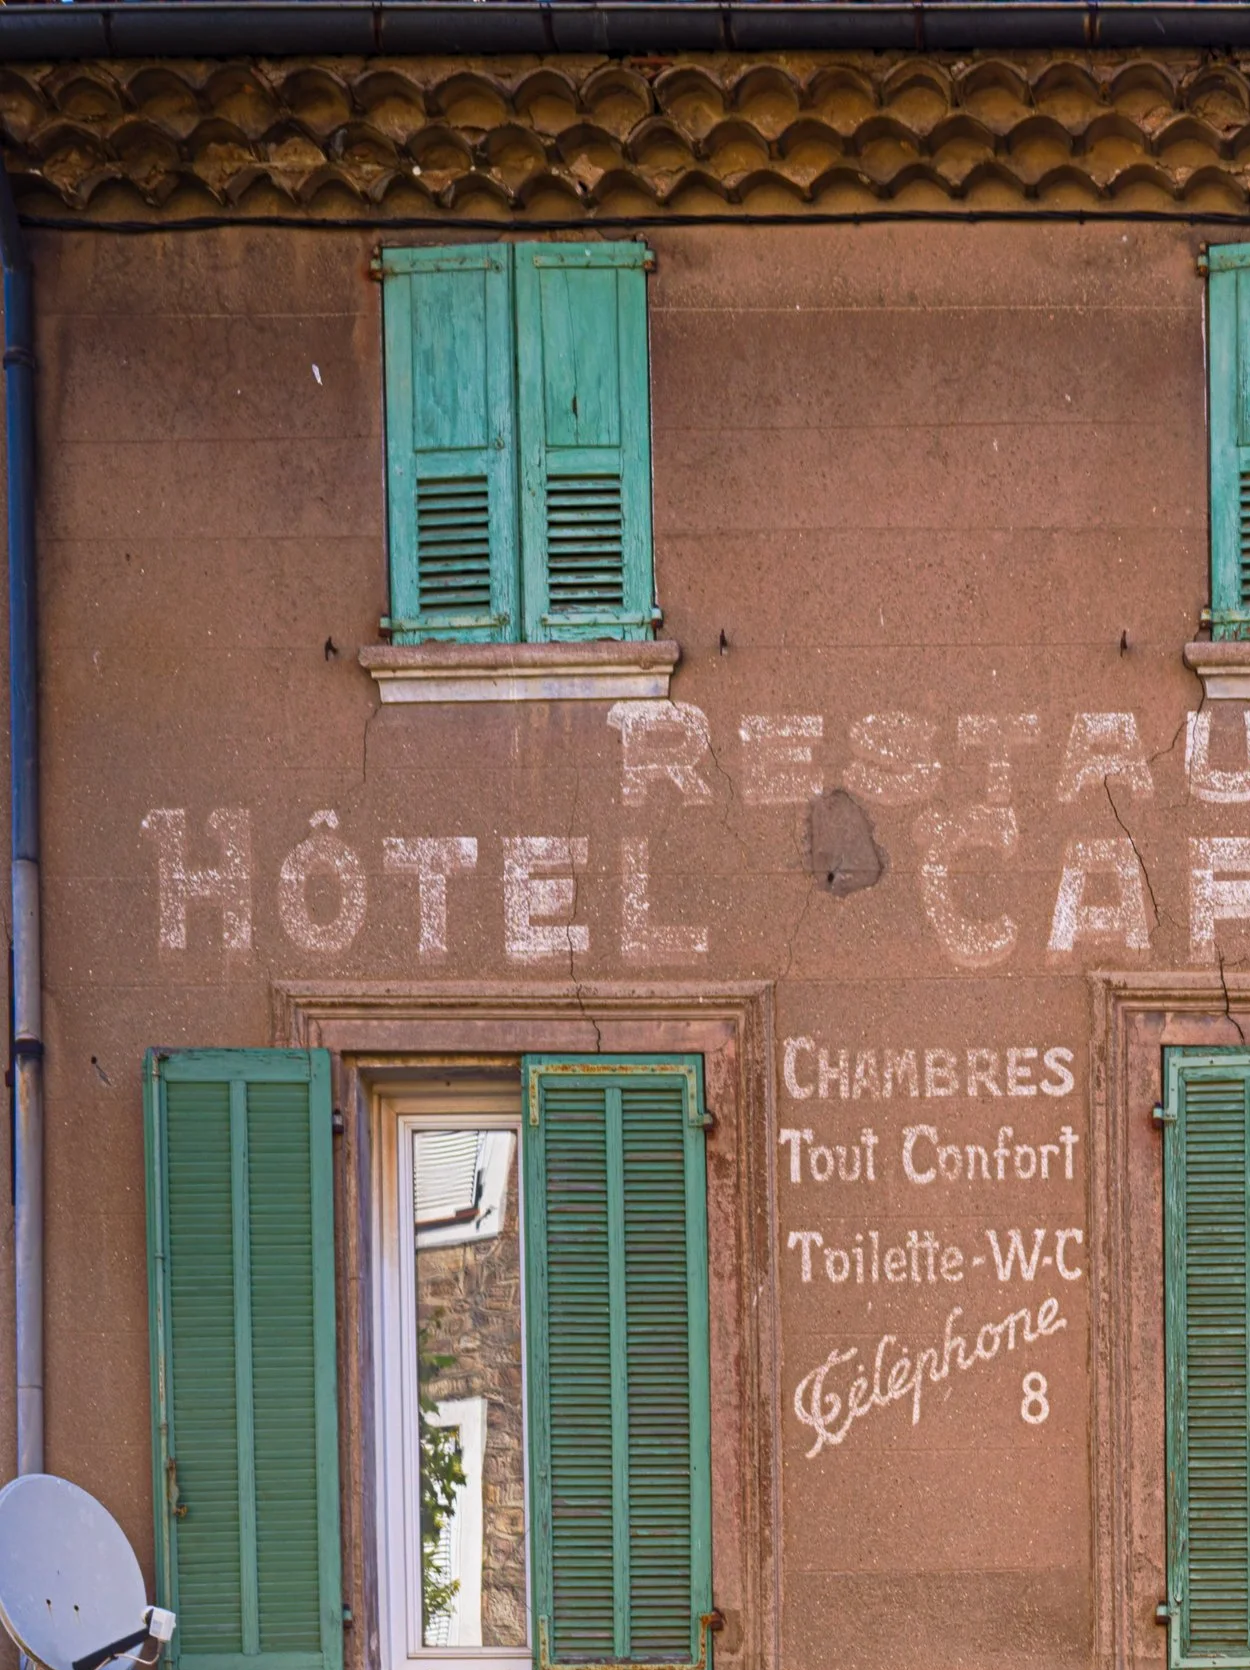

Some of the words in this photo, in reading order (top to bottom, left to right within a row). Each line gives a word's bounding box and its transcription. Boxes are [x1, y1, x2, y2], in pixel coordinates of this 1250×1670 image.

[141, 808, 708, 958] HÔTEL
[783, 1036, 1075, 1099] CHAMBRES
[778, 1127, 878, 1183] Tout
[902, 1124, 1079, 1184] Confort
[1021, 1372, 1050, 1424] 8
